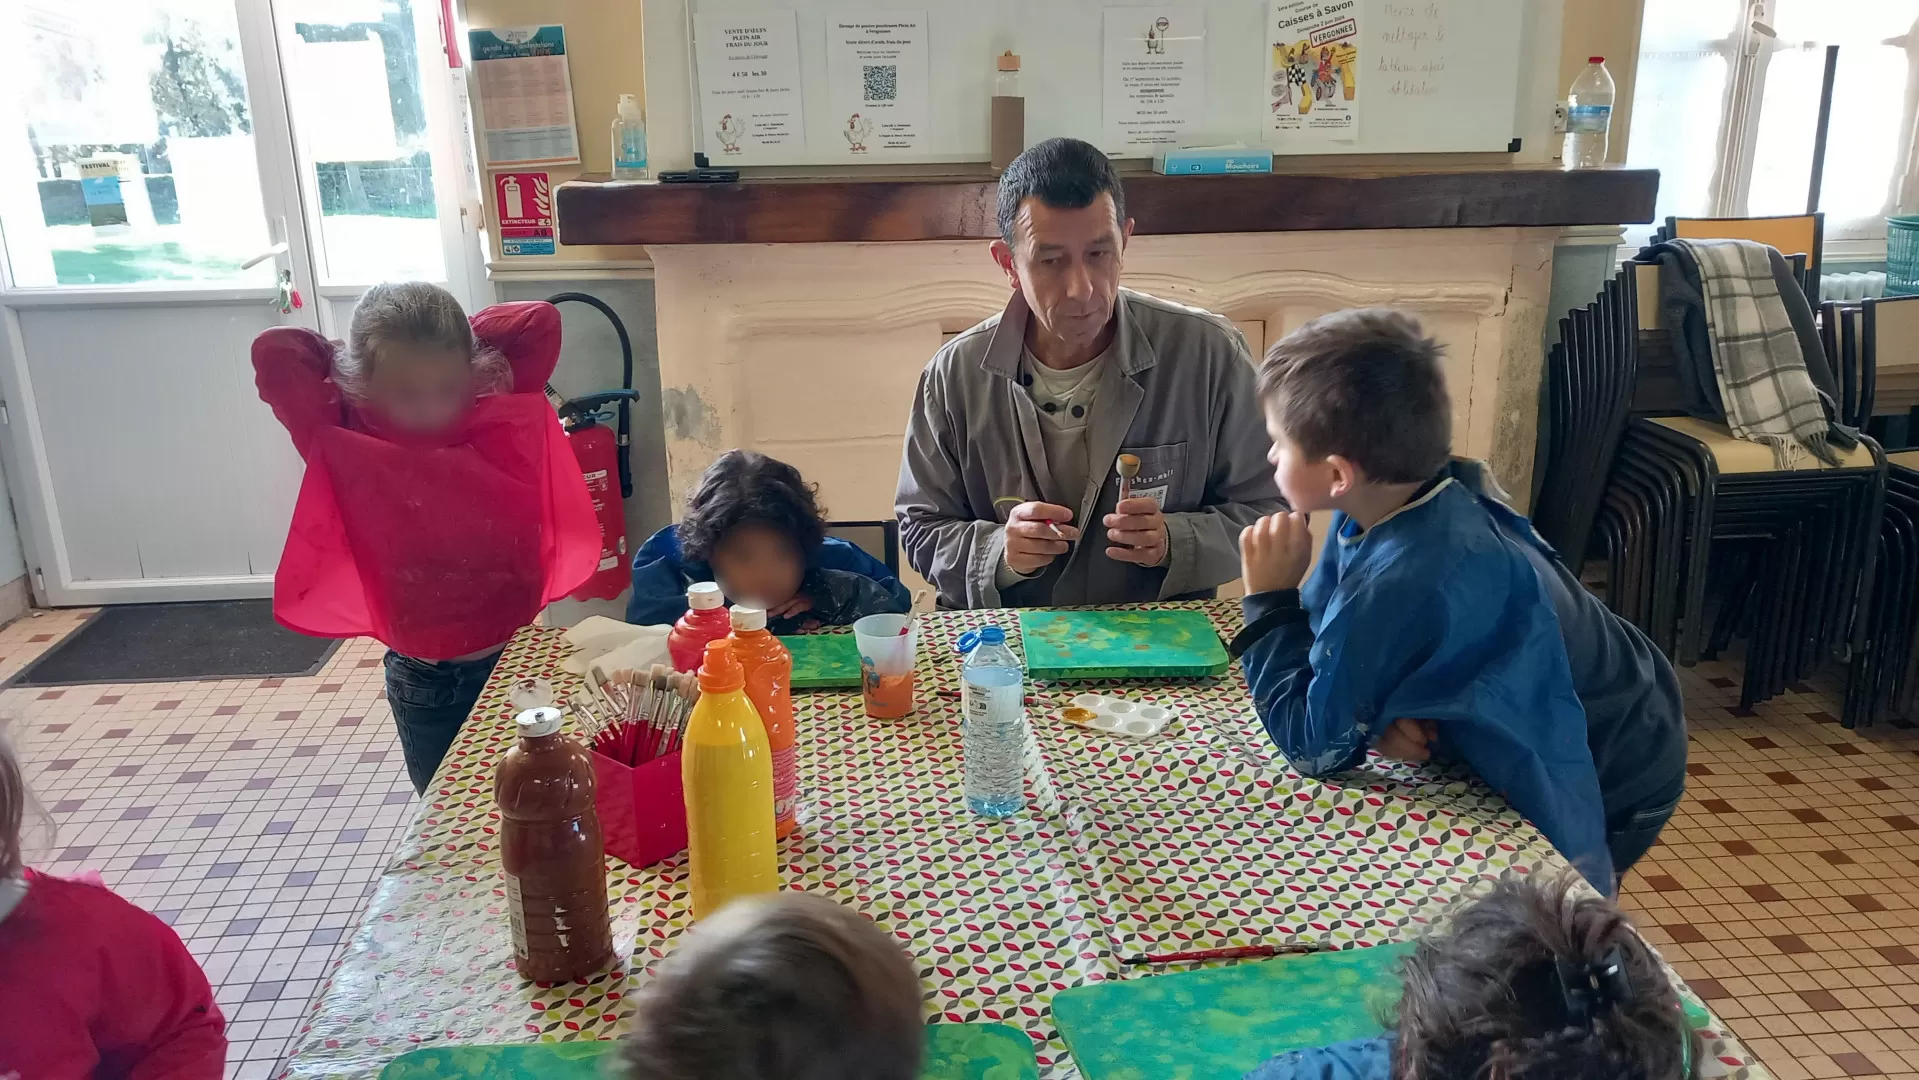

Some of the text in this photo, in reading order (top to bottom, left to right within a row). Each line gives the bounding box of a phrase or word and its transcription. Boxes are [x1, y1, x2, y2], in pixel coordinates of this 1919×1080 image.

[1278, 0, 1354, 28] Caisses à Savon
[1313, 24, 1353, 42] VERGONNES
